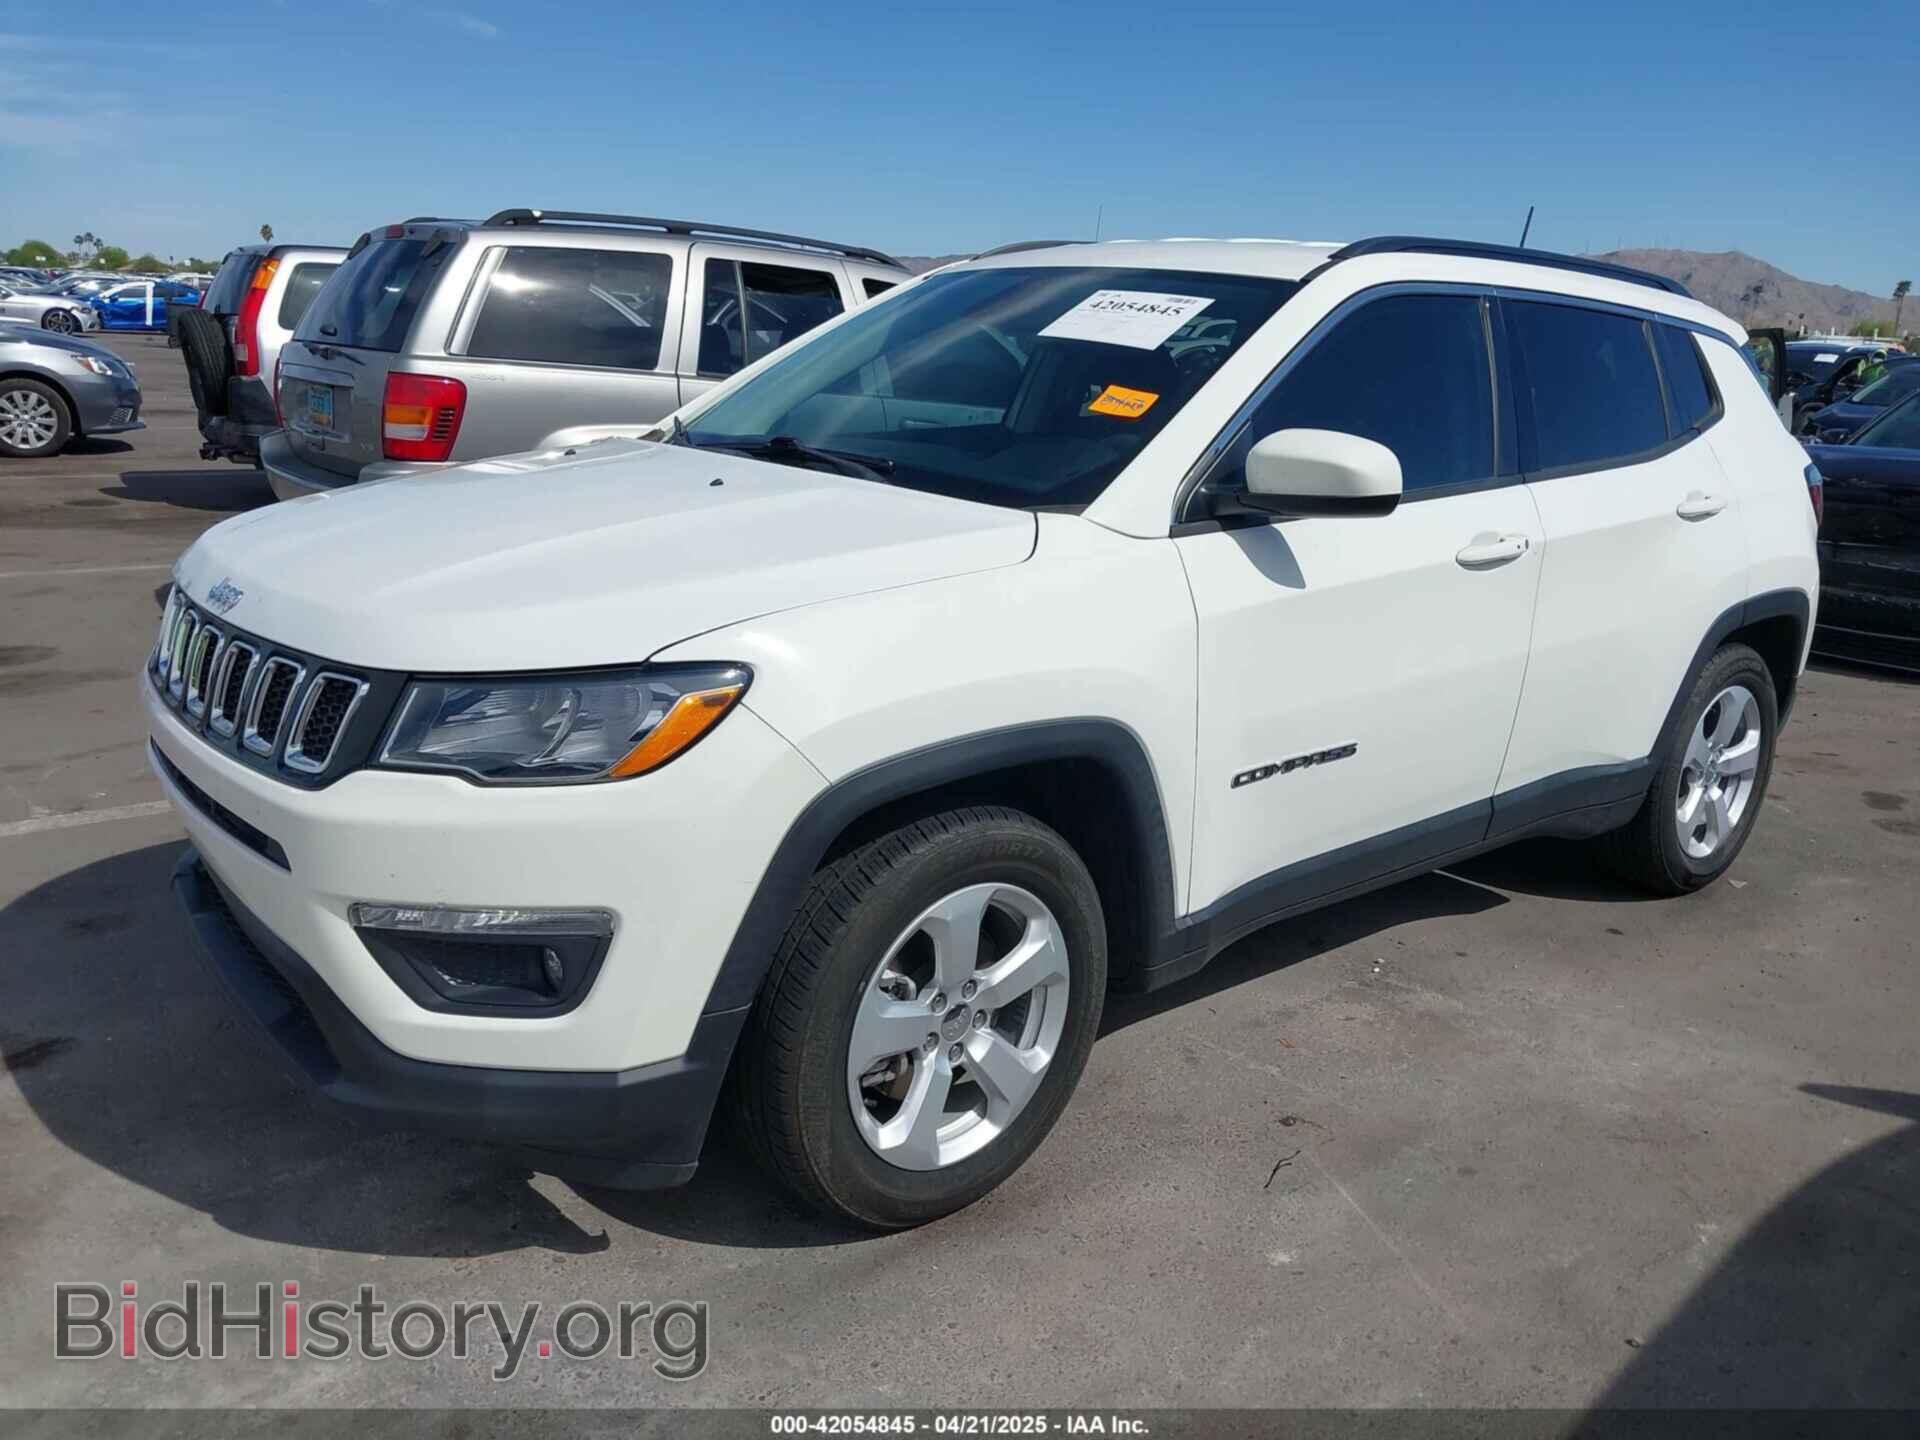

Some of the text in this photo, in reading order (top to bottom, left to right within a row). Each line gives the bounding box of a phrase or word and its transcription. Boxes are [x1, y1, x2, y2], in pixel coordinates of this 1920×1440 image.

[1089, 300, 1185, 317] 42054845
[208, 576, 244, 616] Jeep
[1231, 743, 1358, 788] COMPASS
